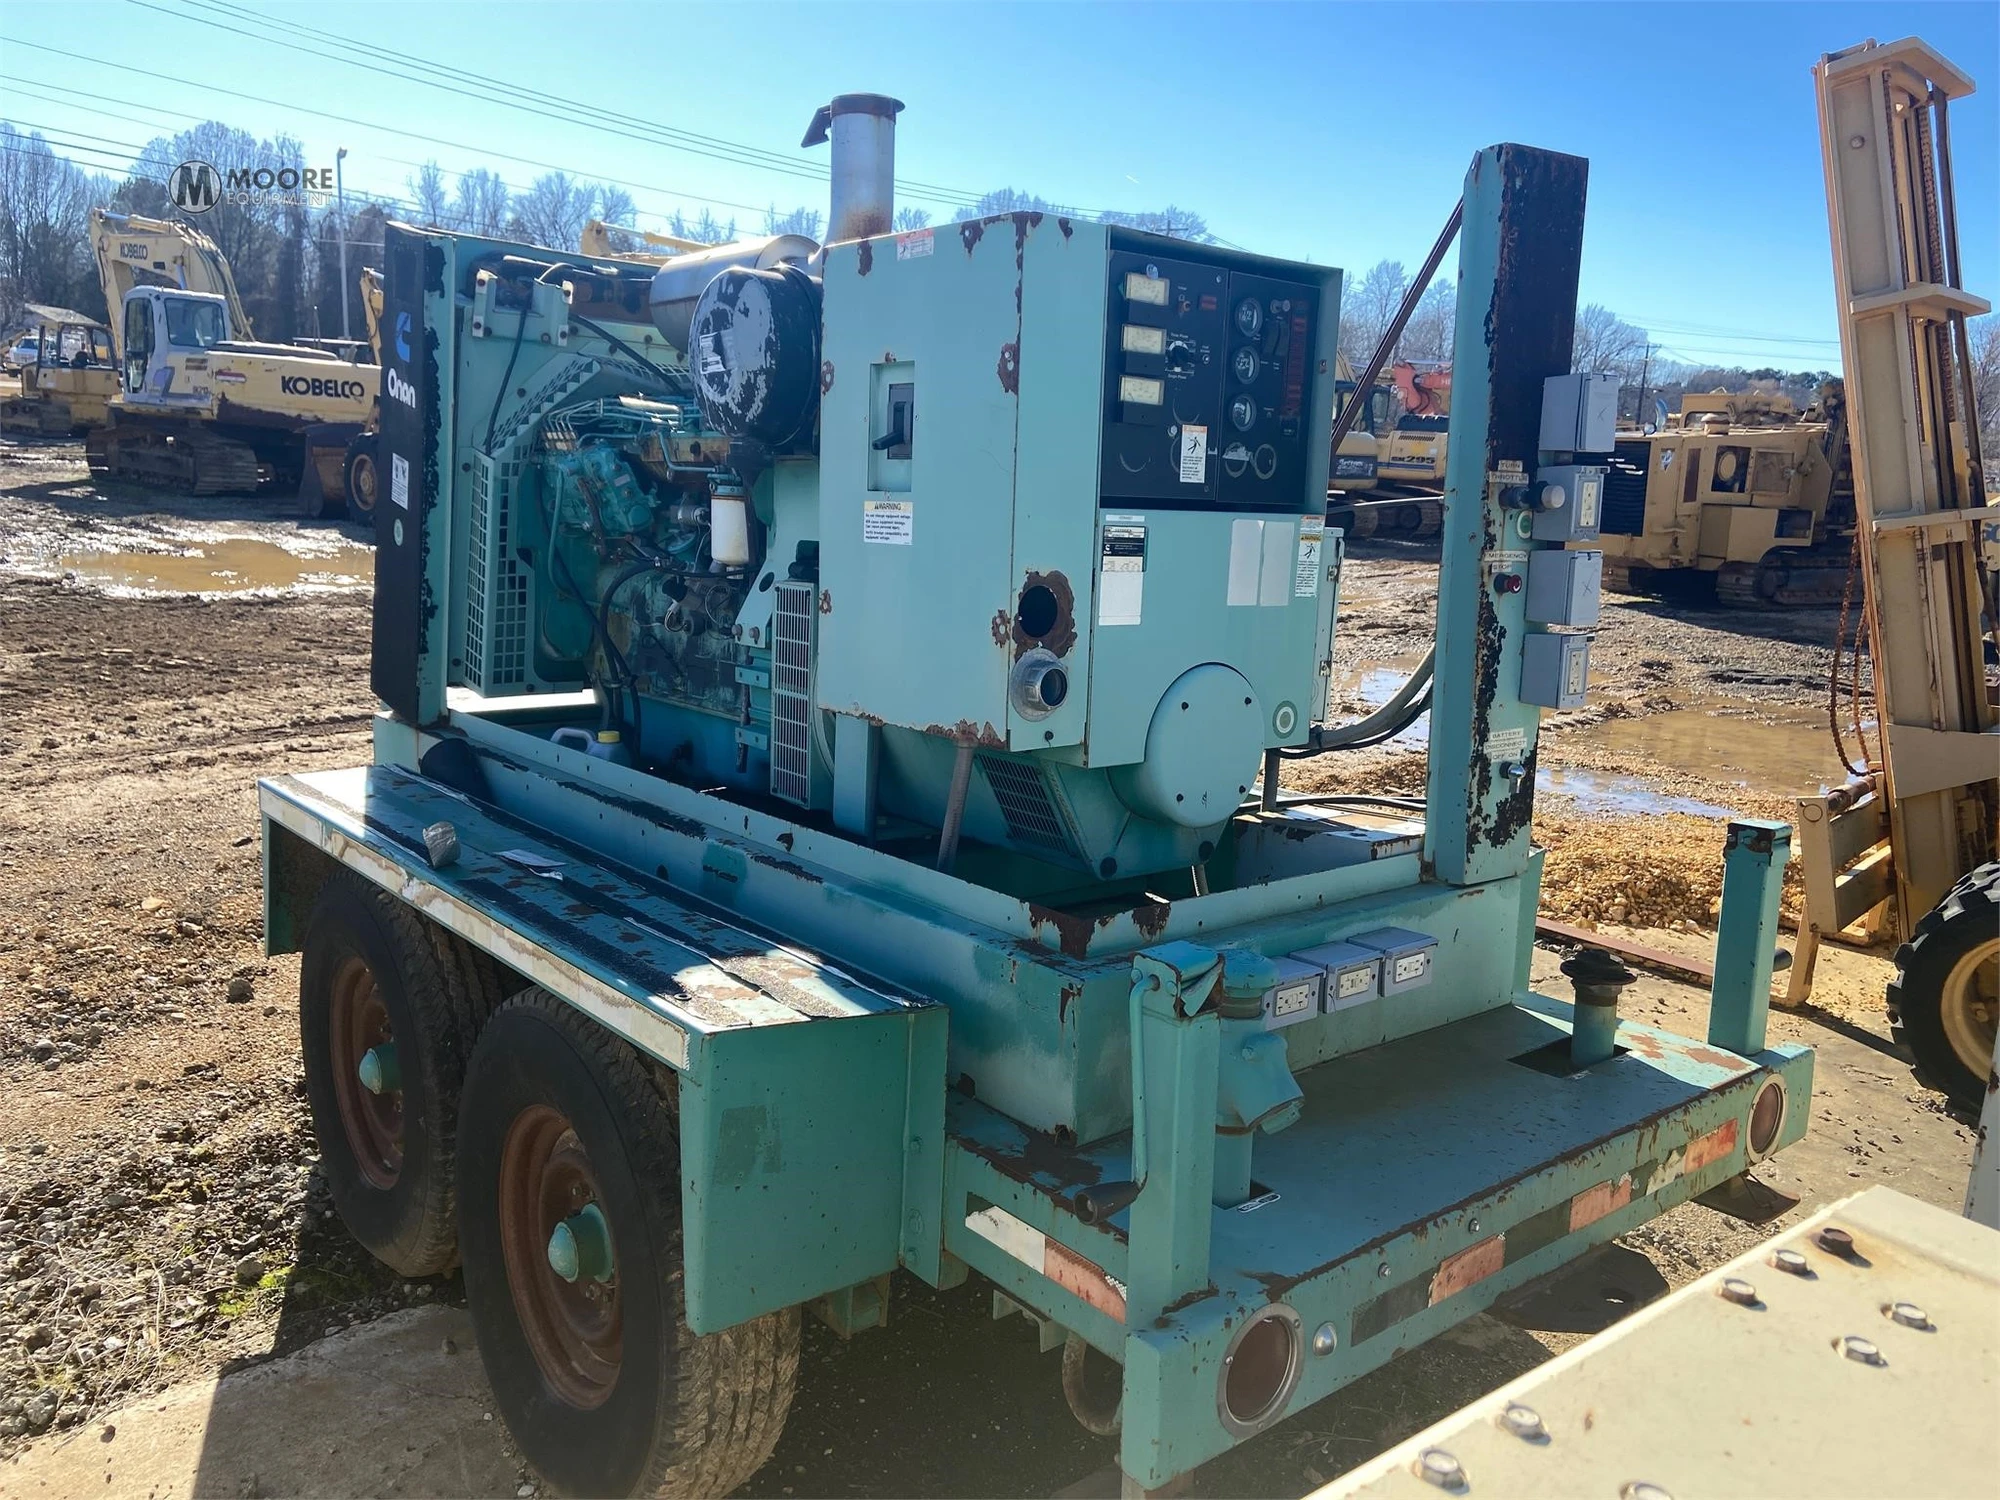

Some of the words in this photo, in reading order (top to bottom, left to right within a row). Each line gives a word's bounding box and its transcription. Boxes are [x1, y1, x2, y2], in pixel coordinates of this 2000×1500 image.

[120, 242, 148, 260] KOBELCO
[281, 375, 365, 399] KOBELCO
[387, 367, 416, 409] Onan
[1485, 740, 1526, 750] DISCONNECT
